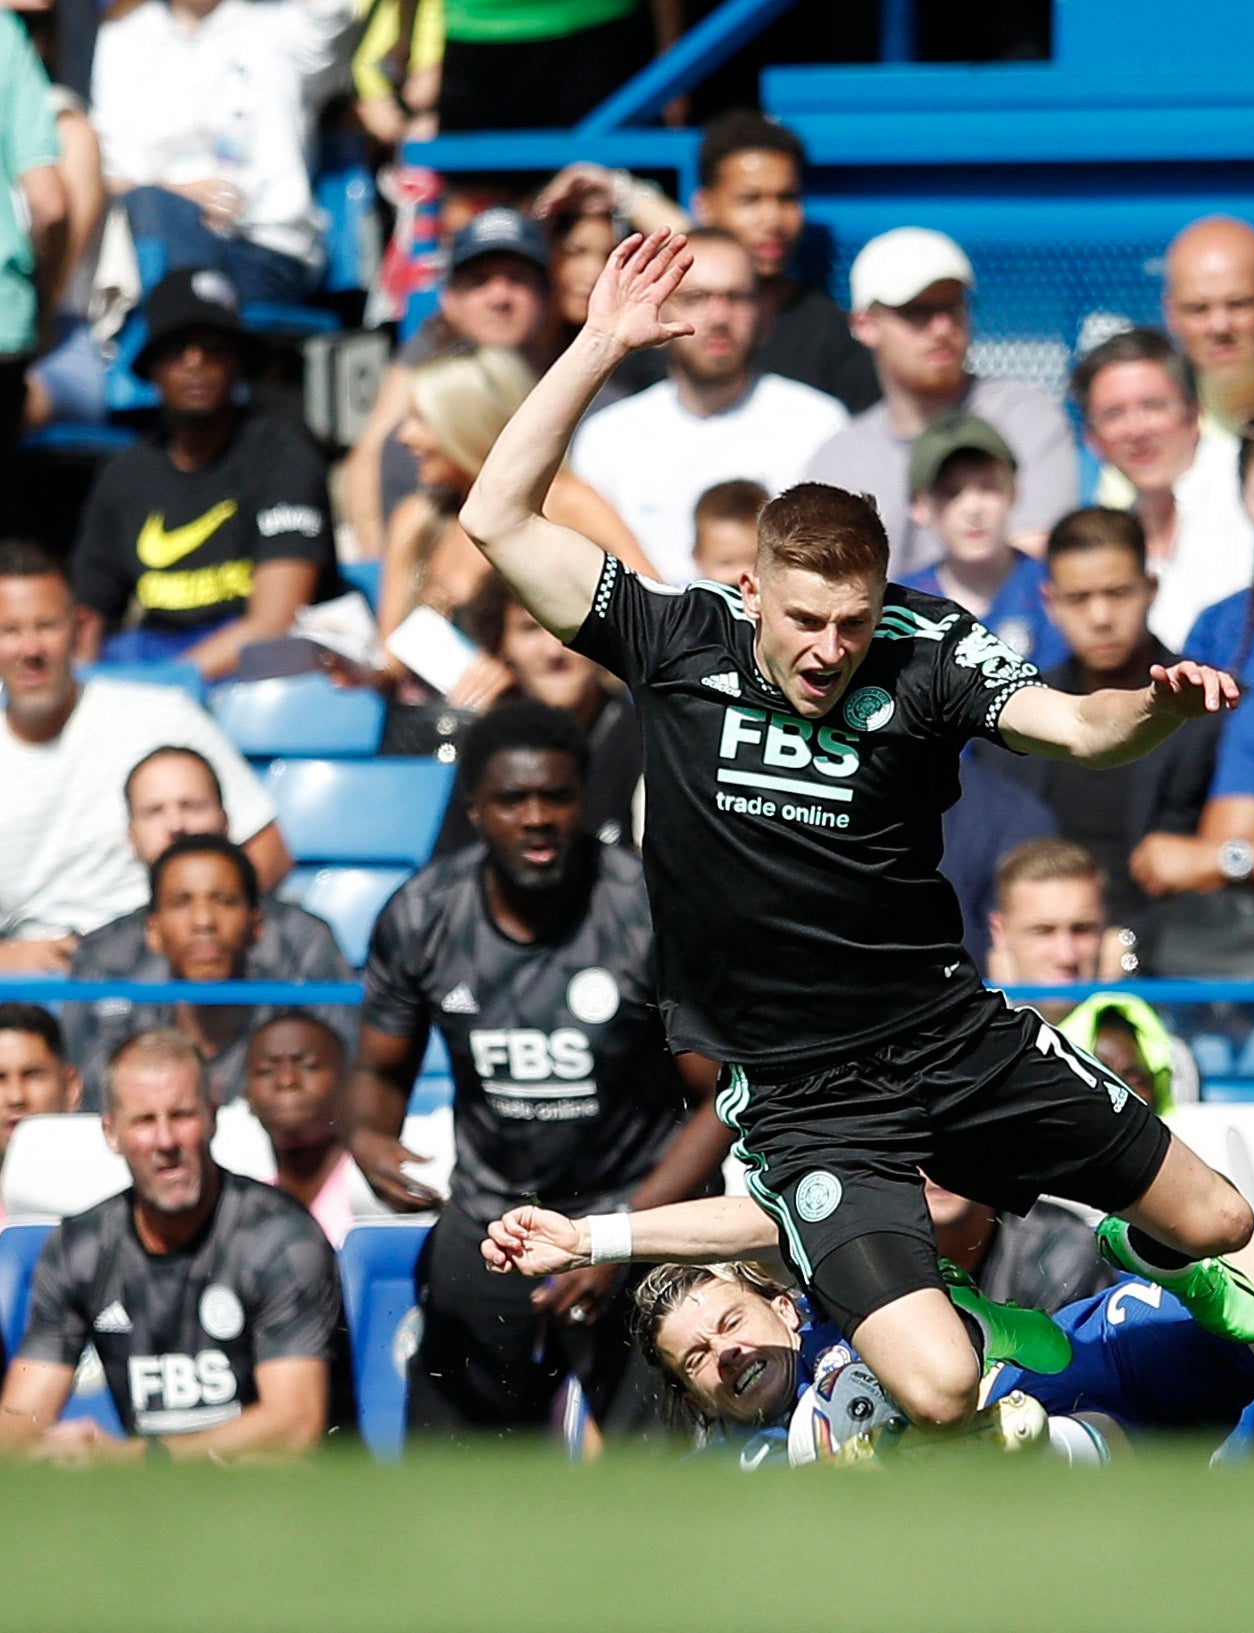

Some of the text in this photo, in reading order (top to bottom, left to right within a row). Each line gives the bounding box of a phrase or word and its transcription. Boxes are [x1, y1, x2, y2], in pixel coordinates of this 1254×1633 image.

[719, 705, 860, 778] FBS
[715, 791, 850, 828] trade online
[469, 1027, 594, 1080] FBS
[1035, 1023, 1097, 1089] 7
[1106, 1282, 1162, 1325] 2
[127, 1349, 237, 1412] FBS
